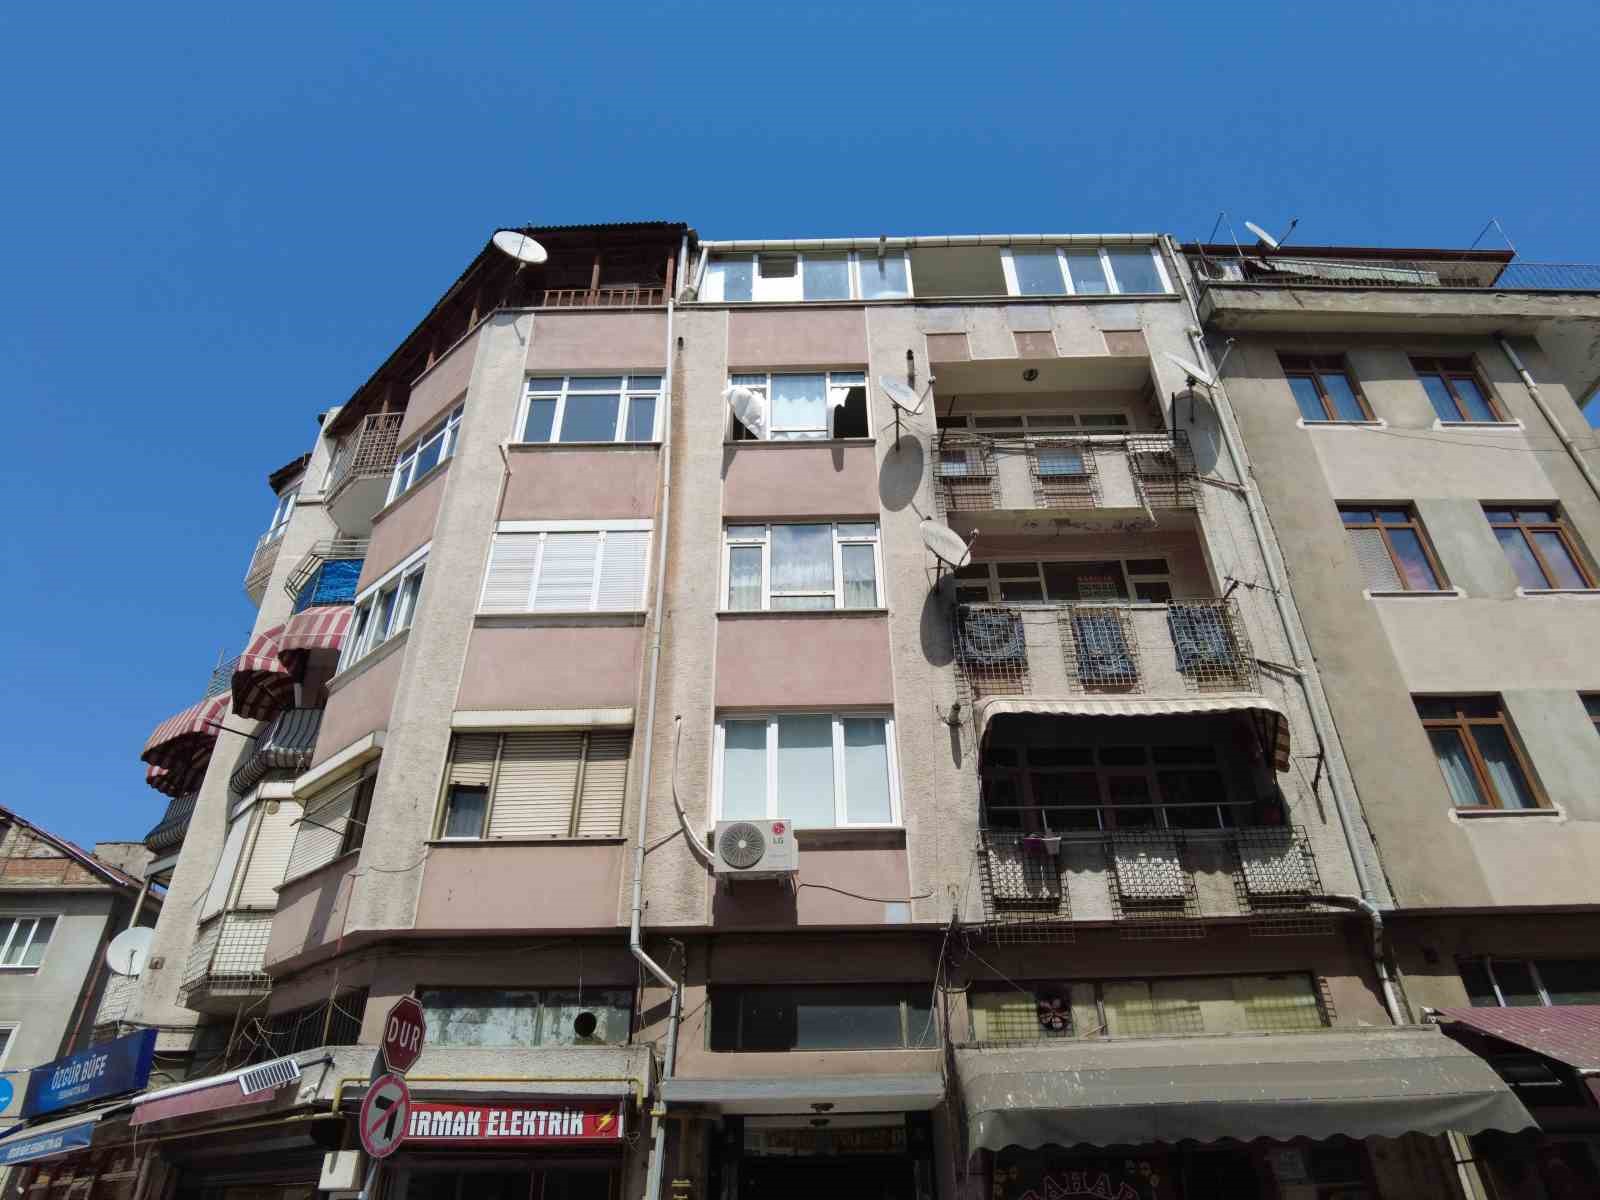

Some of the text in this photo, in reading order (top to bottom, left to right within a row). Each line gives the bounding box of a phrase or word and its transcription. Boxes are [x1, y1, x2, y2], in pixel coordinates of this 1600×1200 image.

[387, 1016, 422, 1053] DUR
[80, 1054, 109, 1081] BÜFE
[408, 1107, 584, 1136] IRMAK ELEKTRİK
